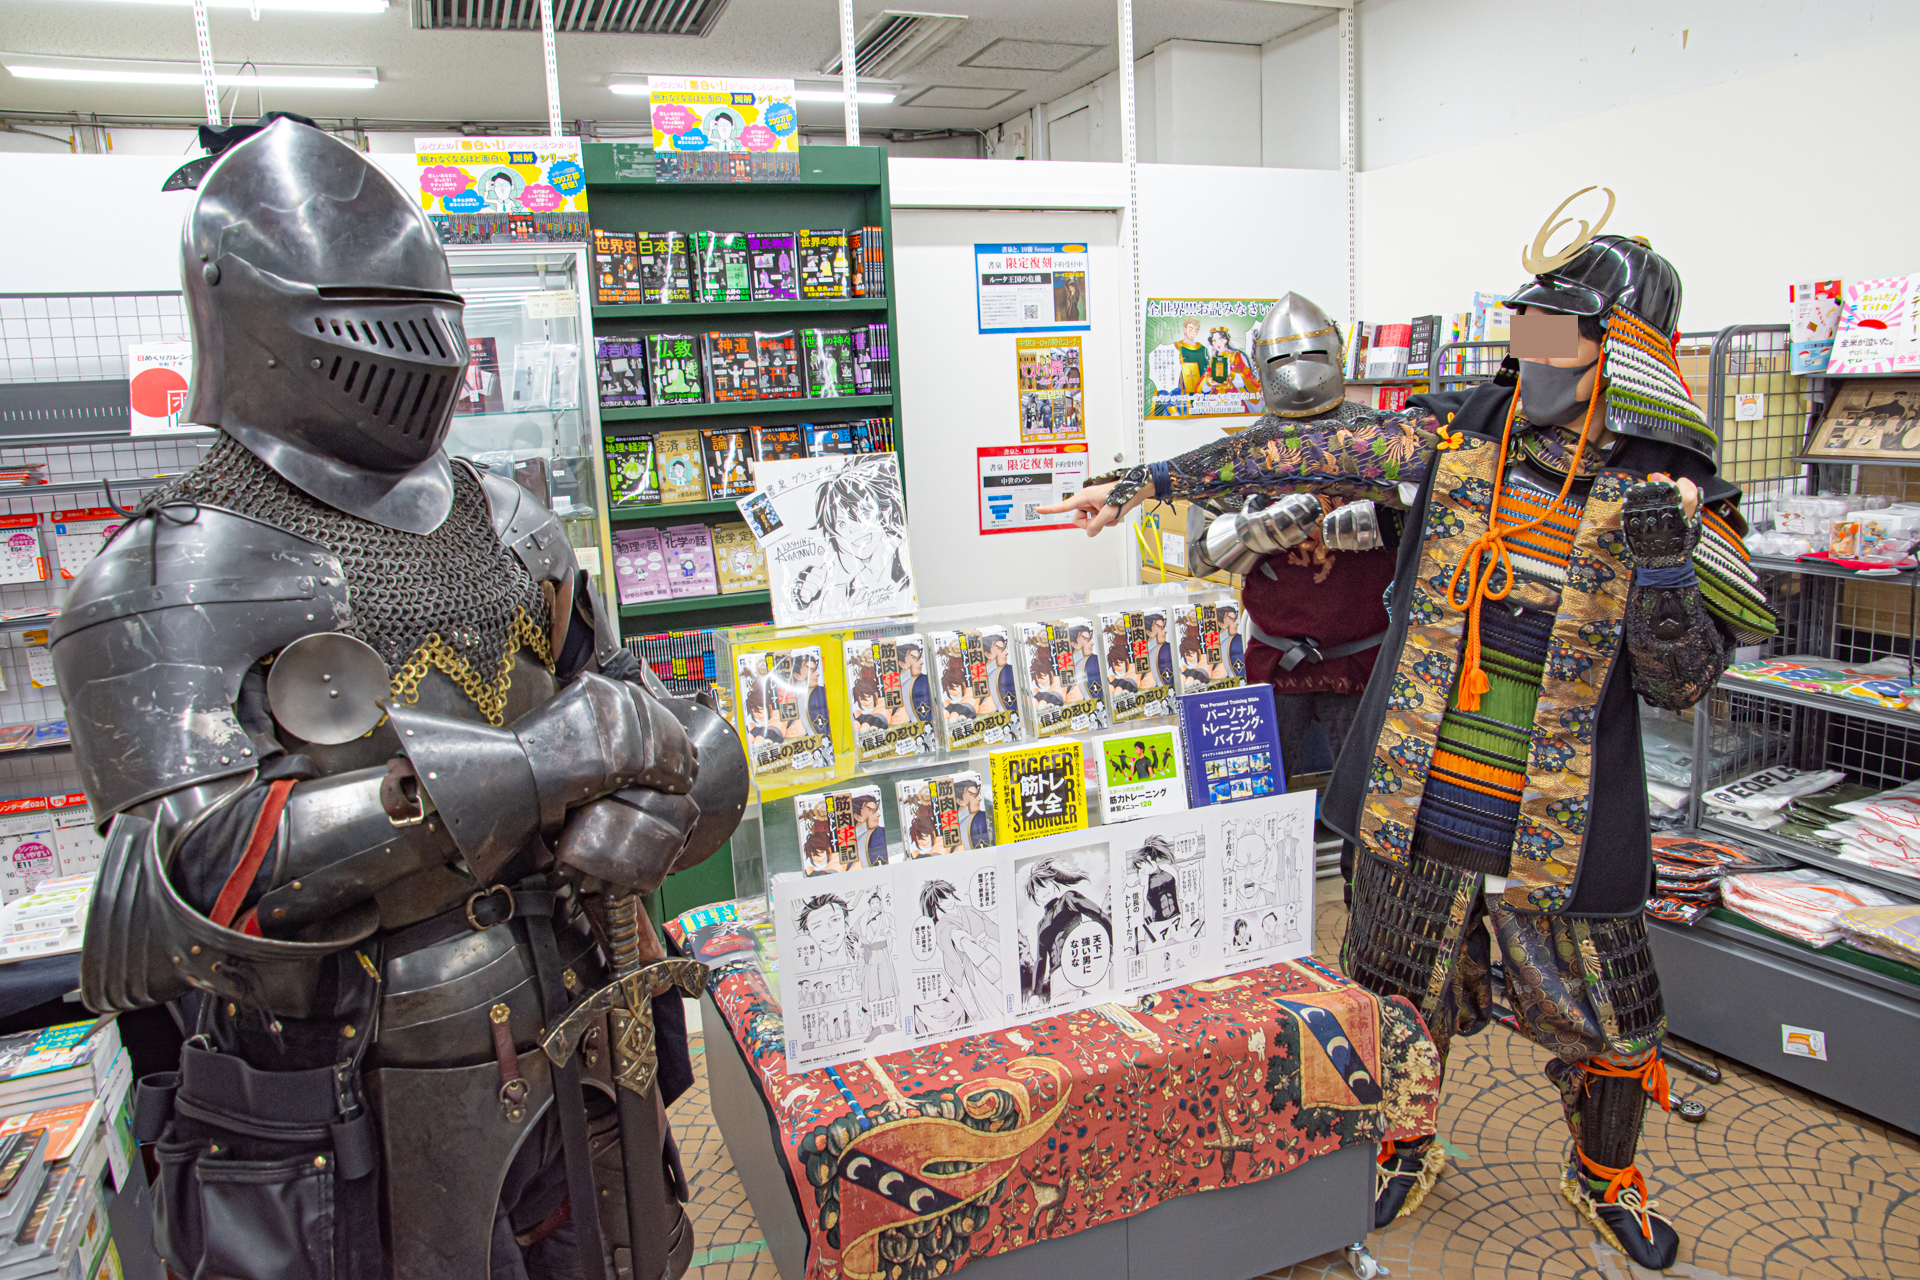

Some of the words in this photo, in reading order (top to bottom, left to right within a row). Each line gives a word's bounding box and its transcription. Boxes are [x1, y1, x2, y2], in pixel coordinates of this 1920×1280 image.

[653, 93, 730, 102] 眠れなくなるほど面白い
[758, 95, 791, 104] シリーズ
[421, 154, 507, 163] 眠れなくなるほど面白い
[539, 153, 578, 163] シリーズ
[595, 238, 637, 254] 世界史
[640, 240, 686, 254] 日本史
[750, 238, 794, 249] 源氏物語
[801, 237, 848, 248] 世界の宗教
[988, 261, 1002, 269] 書泉
[1005, 257, 1052, 269] 限定復刻
[990, 275, 1042, 283] ルータ王国の危機
[599, 344, 642, 357] 般若心経
[655, 340, 694, 358] 仏教
[717, 338, 749, 354] 神道
[758, 338, 795, 350] 神社の話
[1840, 338, 1893, 347] 全米が泣いた。
[1022, 360, 1064, 378] ヒストリ屋
[657, 438, 699, 453] 経済の話
[711, 434, 744, 450] 論語
[990, 464, 1003, 472] 書泉
[1007, 457, 1054, 470] 限定復刻
[1001, 476, 1033, 484] 中世のパン
[617, 540, 659, 554] 物理の話
[666, 536, 707, 548] 化学の話
[1203, 605, 1221, 662] 筋肉軍記
[1130, 614, 1149, 672] 筋肉軍記
[1054, 625, 1075, 686] 筋肉軍記
[968, 635, 989, 697] 筋肉軍記
[881, 643, 902, 707] 筋肉軍記
[1116, 687, 1164, 713] 信長の忍び
[1229, 698, 1247, 706] Training
[1040, 702, 1092, 728] 信長の忍び
[1206, 705, 1257, 721] パーソナル
[952, 715, 1006, 741] 信長の忍び
[863, 723, 919, 752] 信長の忍び
[1214, 730, 1255, 746] バイブル
[757, 738, 817, 767] 信長の忍び
[1009, 752, 1074, 785] BIGGER
[1020, 773, 1064, 796] 筋トレ
[1108, 785, 1145, 795] スポーツのための
[1109, 788, 1167, 805] 筋力トレーニング
[1025, 793, 1063, 817] 大全
[1110, 804, 1140, 812] 練習メニュー
[1140, 800, 1152, 808] 120
[937, 781, 960, 846] 筋肉軍記
[835, 796, 857, 862] 筋肉軍記
[1132, 892, 1140, 913] 信長の
[1071, 940, 1079, 967] なりな
[1093, 934, 1102, 959] 天下一
[1081, 937, 1091, 974] 強い男に
